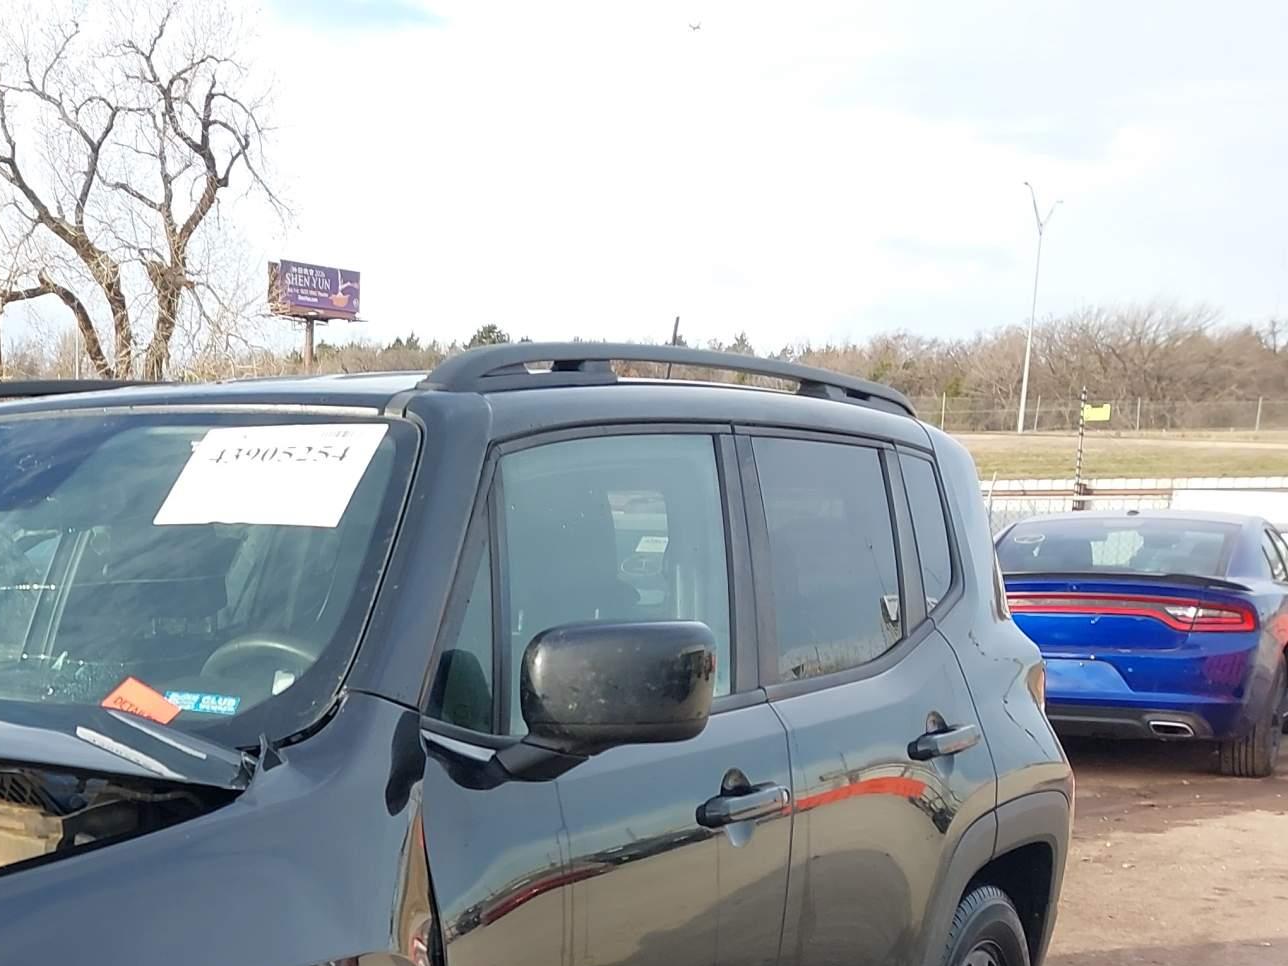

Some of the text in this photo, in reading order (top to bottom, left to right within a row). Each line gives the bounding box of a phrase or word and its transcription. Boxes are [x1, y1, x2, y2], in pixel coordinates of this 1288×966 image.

[285, 272, 330, 291] SHEN YUN
[208, 446, 351, 464] 43905254
